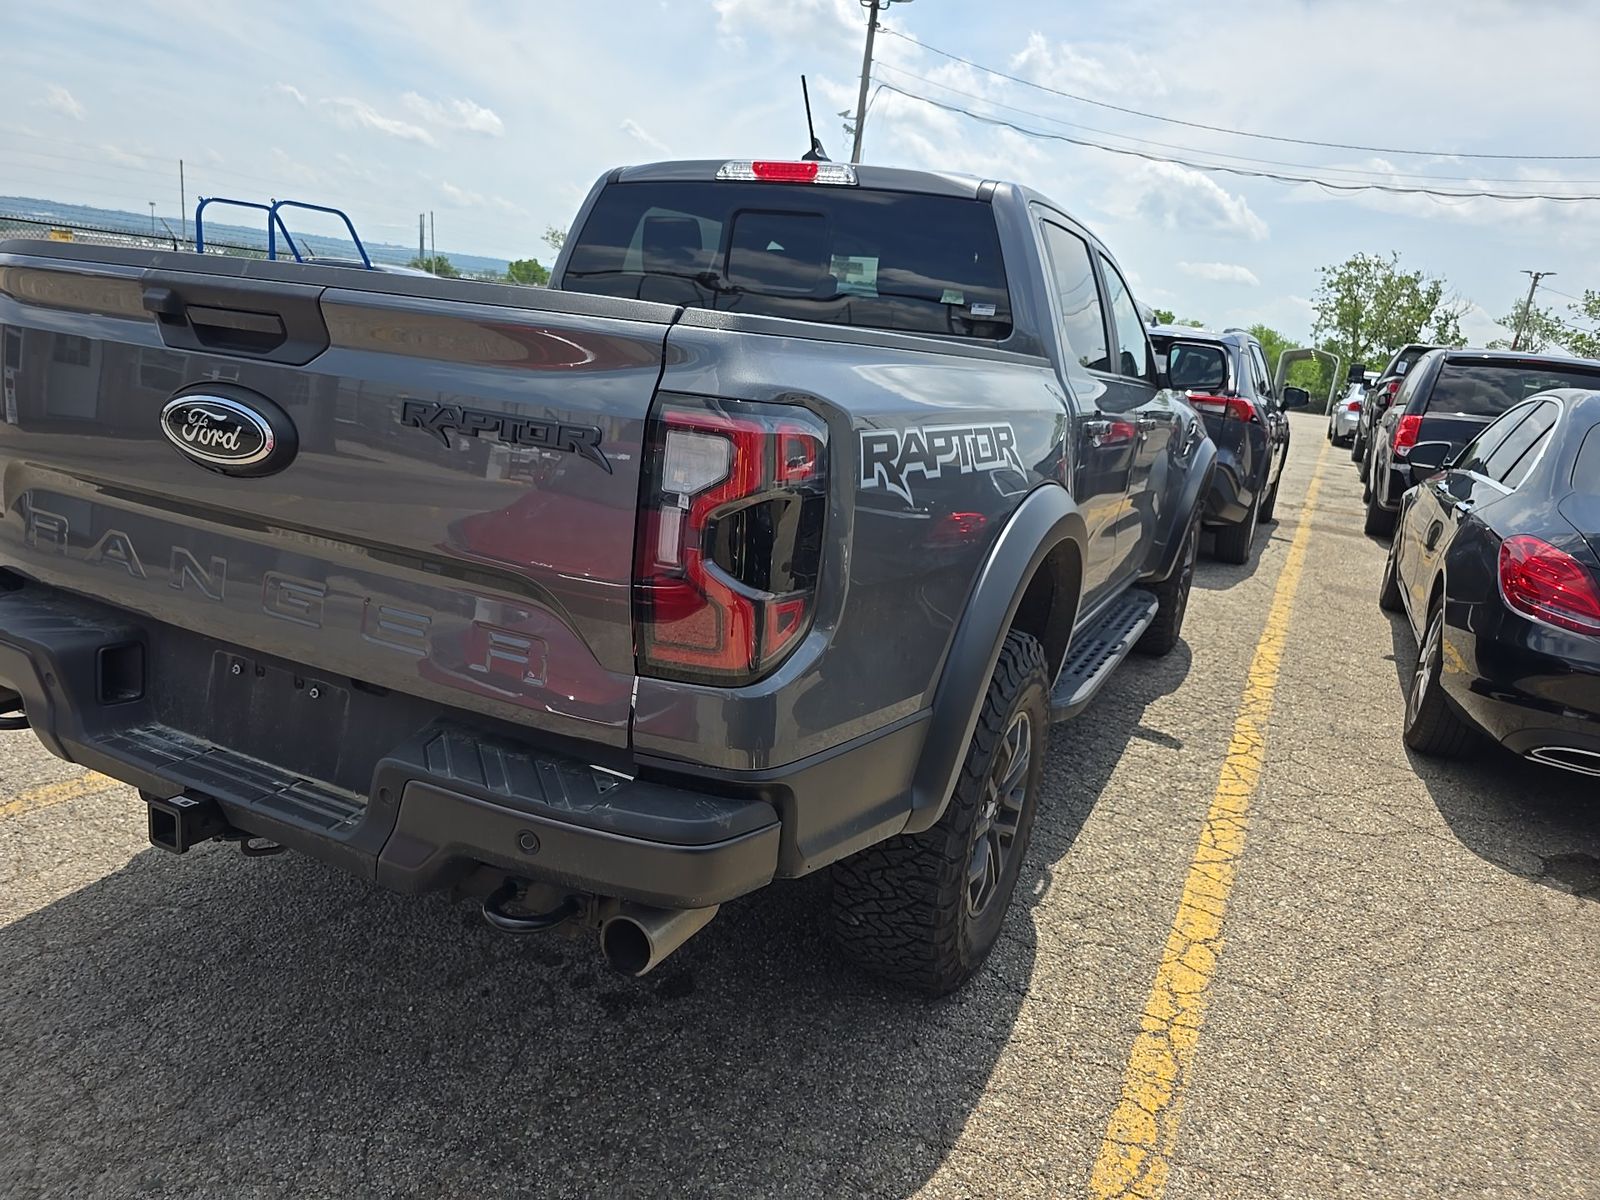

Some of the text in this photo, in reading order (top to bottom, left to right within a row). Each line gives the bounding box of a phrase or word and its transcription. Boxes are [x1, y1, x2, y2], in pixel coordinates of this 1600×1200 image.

[182, 408, 242, 450] Ford
[401, 398, 613, 475] RAPTOR
[860, 421, 1029, 506] RAPTOR
[23, 490, 549, 688] RANGER
